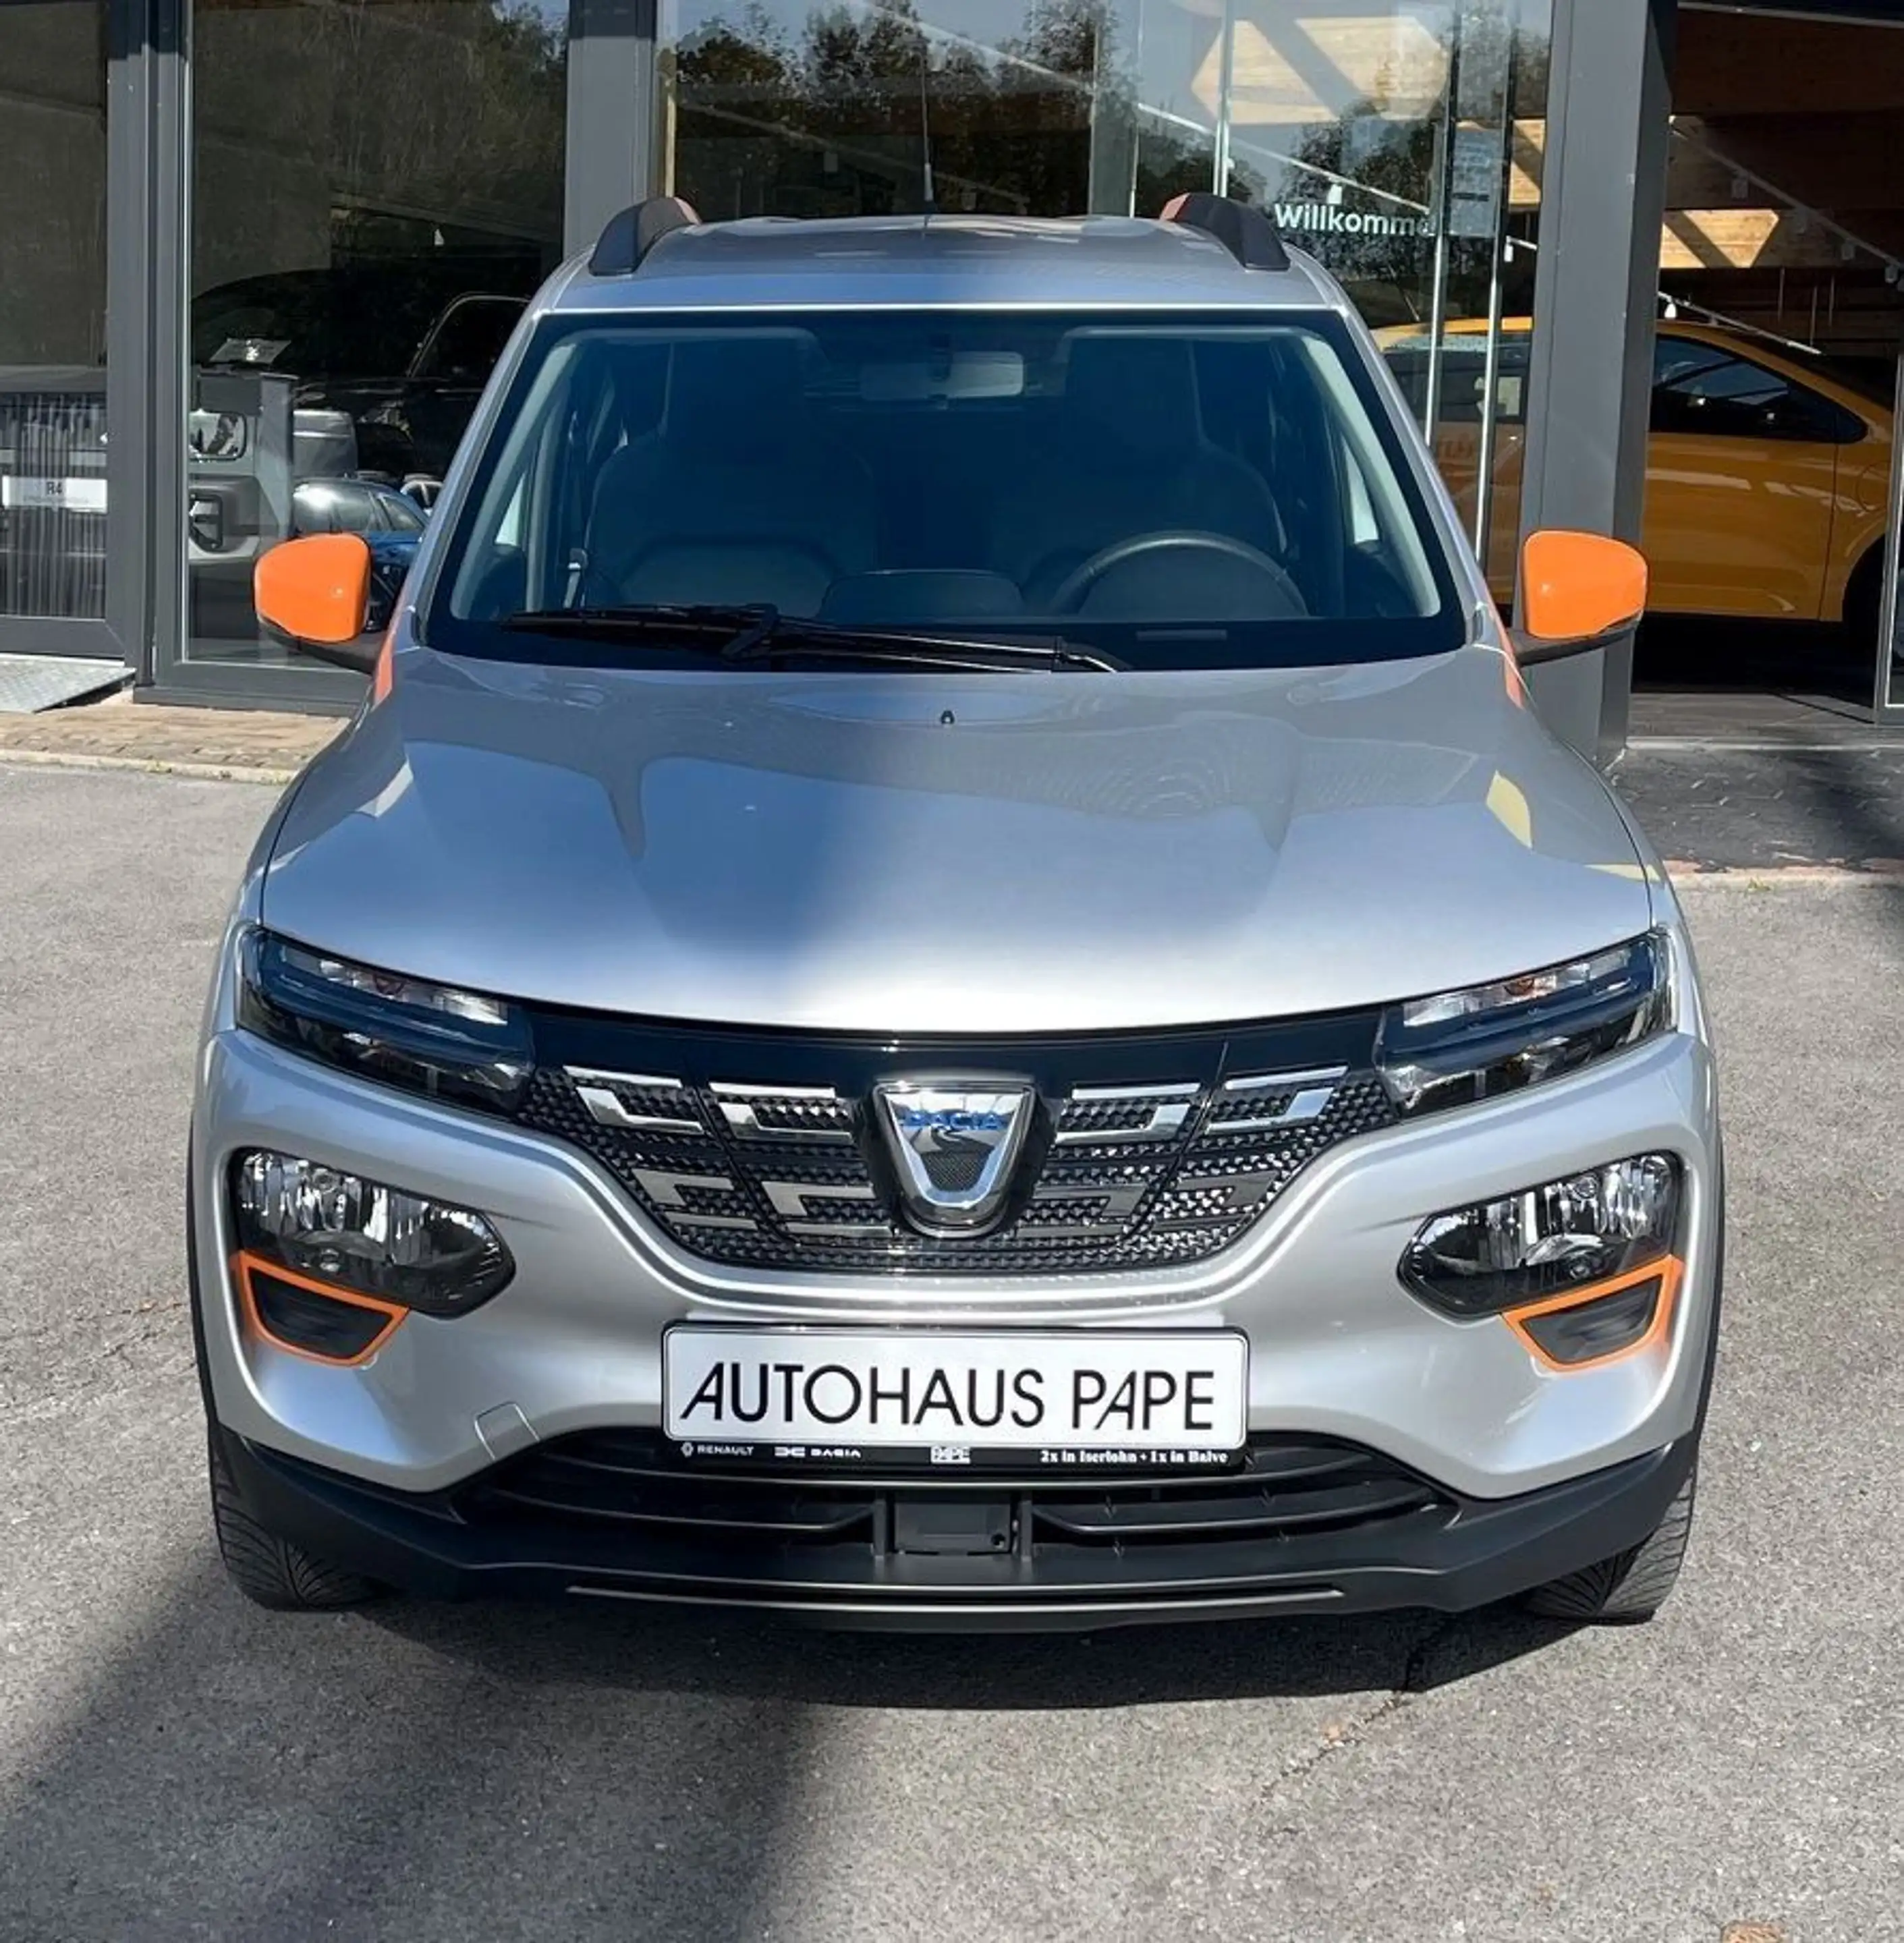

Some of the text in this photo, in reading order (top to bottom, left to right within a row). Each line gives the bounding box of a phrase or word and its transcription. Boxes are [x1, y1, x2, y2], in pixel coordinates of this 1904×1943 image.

[681, 1361, 1214, 1431] AUTOHAUS PAPE
[697, 1444, 754, 1456] RENAULT
[1061, 1450, 1076, 1463] in
[1170, 1451, 1184, 1463] in
[1188, 1451, 1229, 1463] Balve
